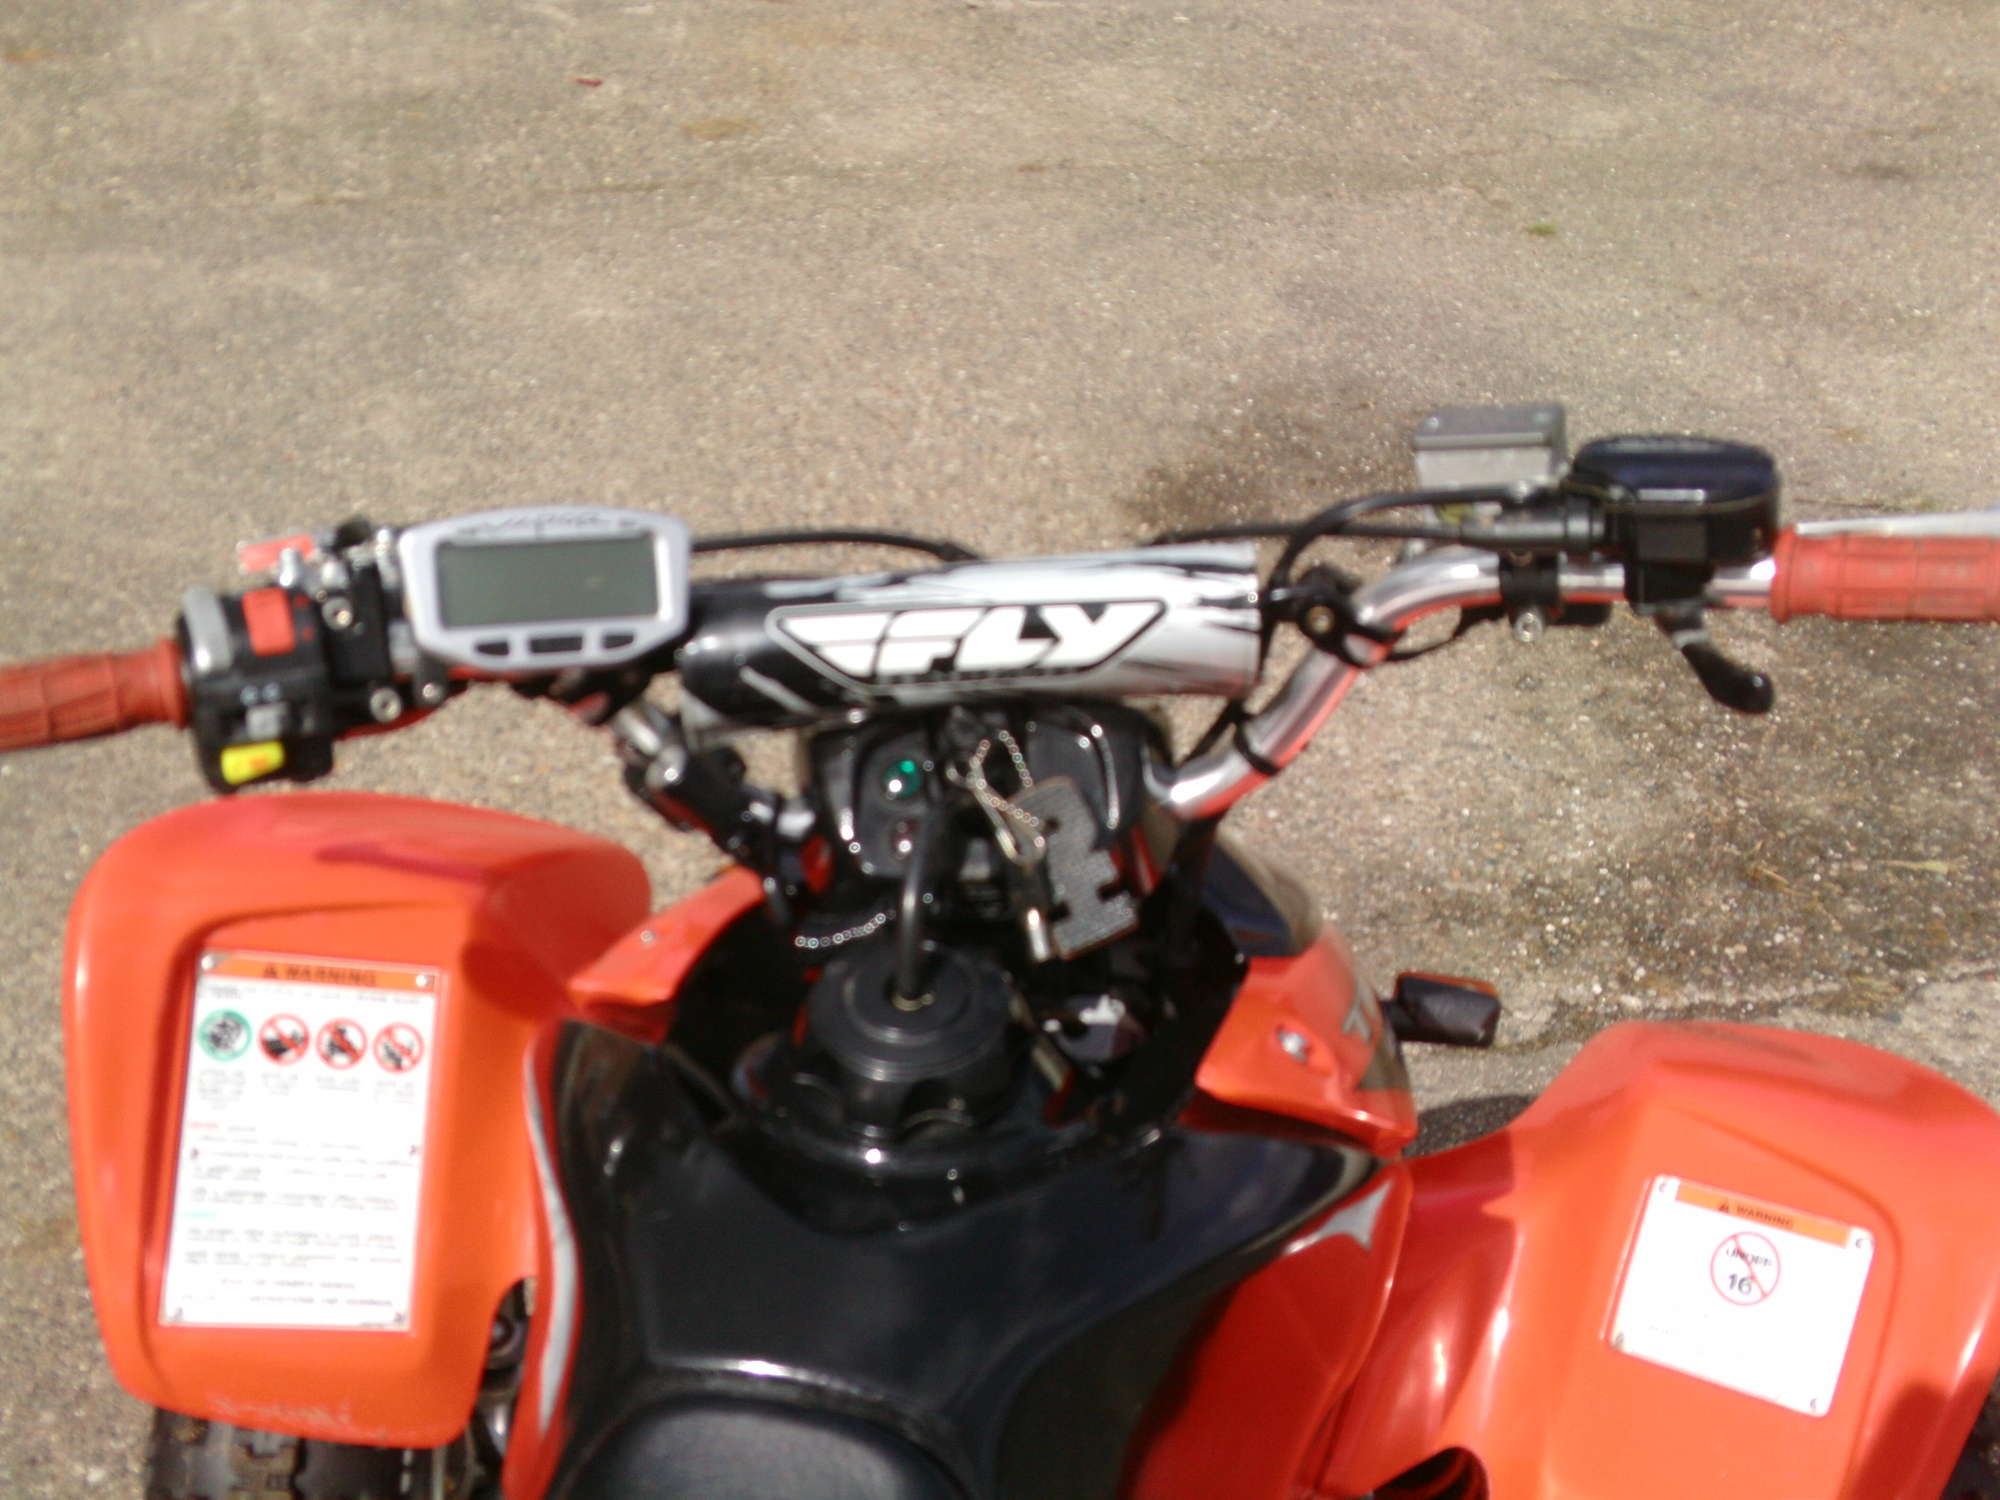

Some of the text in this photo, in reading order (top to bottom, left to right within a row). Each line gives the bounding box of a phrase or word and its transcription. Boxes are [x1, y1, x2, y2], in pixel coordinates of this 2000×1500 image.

[878, 600, 1165, 677] FLY
[285, 965, 377, 987] WARNING
[1736, 1205, 1794, 1230] WARNING
[1728, 1272, 1752, 1295] 16
